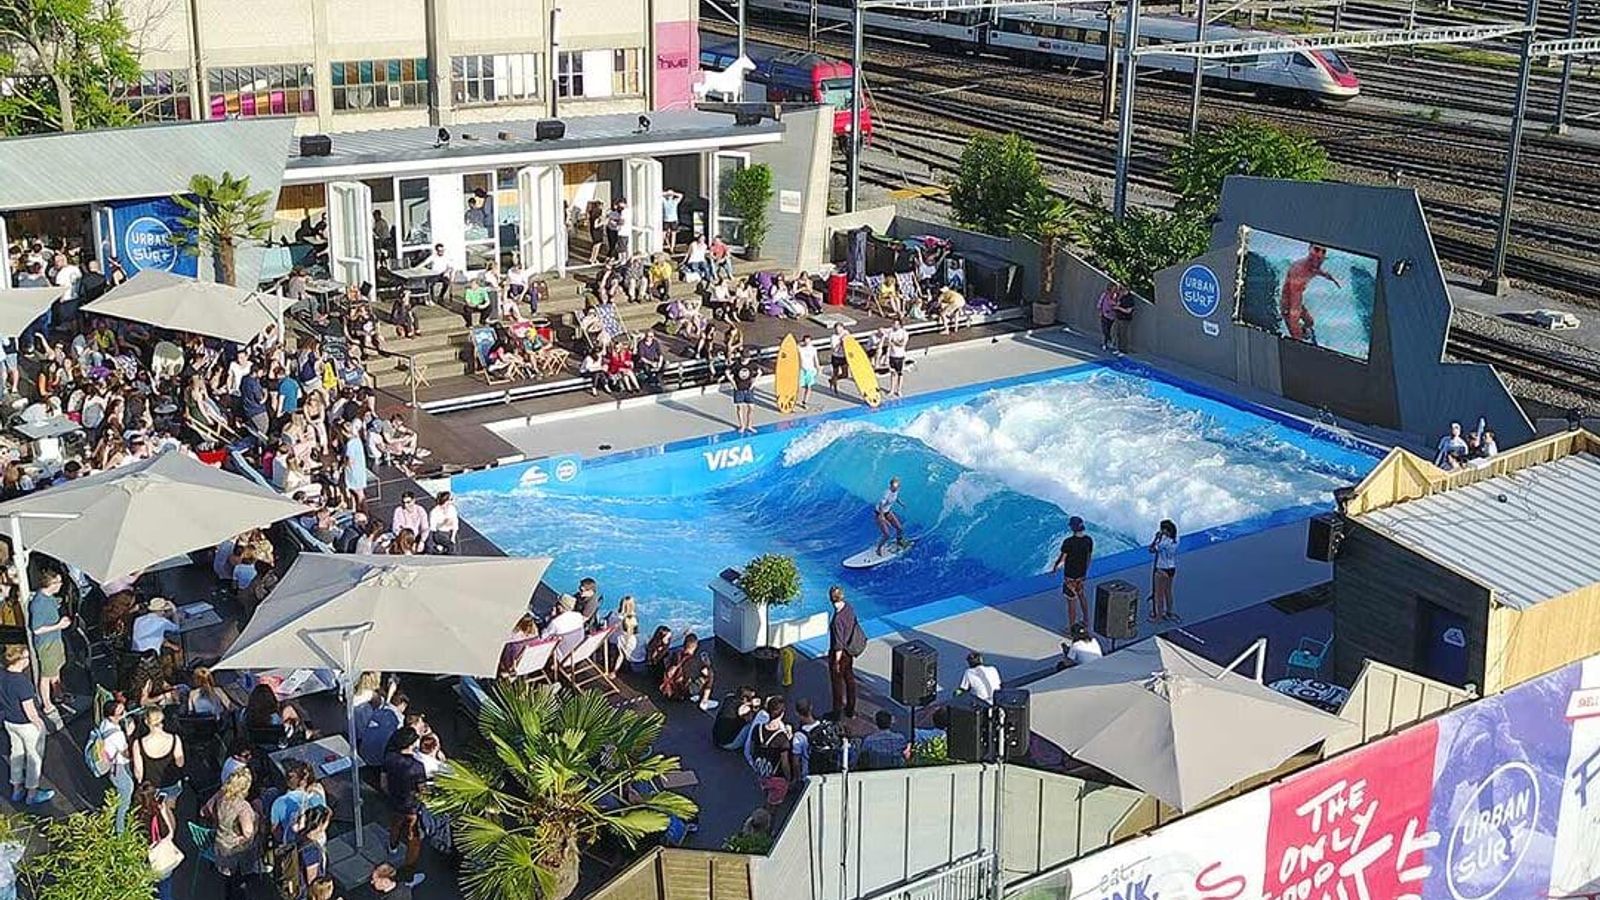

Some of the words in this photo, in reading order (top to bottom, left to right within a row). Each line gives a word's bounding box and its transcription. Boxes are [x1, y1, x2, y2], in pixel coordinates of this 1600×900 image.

[133, 247, 171, 263] SURF
[1184, 290, 1216, 307] SURF
[1185, 277, 1216, 295] URBAN
[703, 444, 754, 472] VISA
[1296, 778, 1368, 834] THE
[1462, 788, 1530, 845] URBAN
[1279, 799, 1379, 885] ONLY
[1455, 820, 1528, 883] SURF
